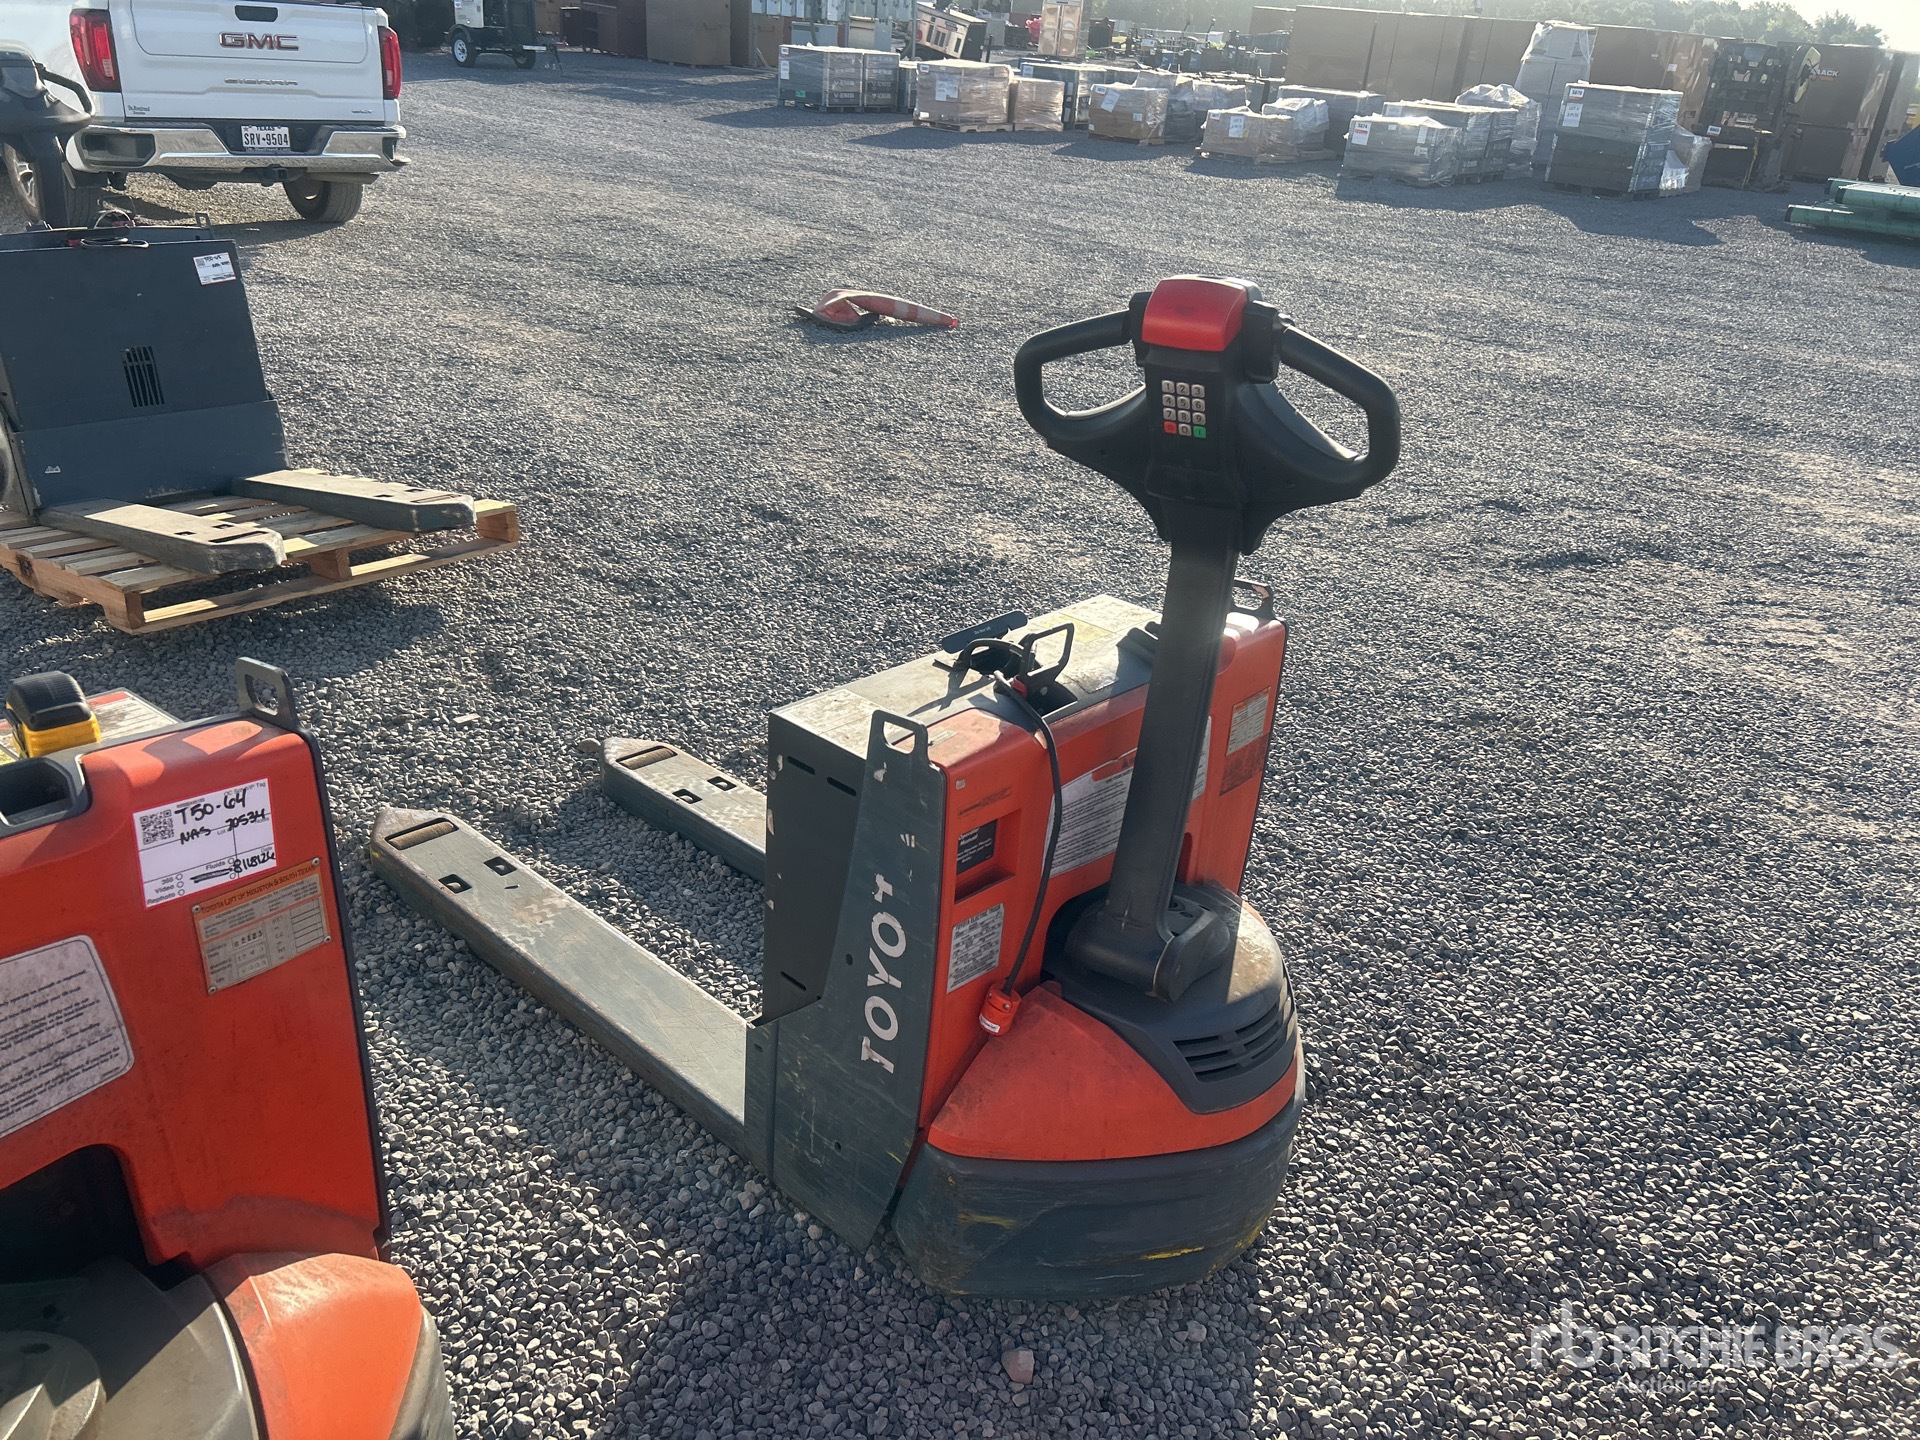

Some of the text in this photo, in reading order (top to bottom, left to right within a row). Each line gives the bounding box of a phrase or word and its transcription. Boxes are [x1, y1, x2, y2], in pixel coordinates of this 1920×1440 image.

[219, 32, 299, 51] GMC
[174, 788, 247, 825] T50-64
[205, 861, 226, 870] Fluids
[155, 884, 175, 894] Video
[861, 833, 915, 1074] TOYOT
